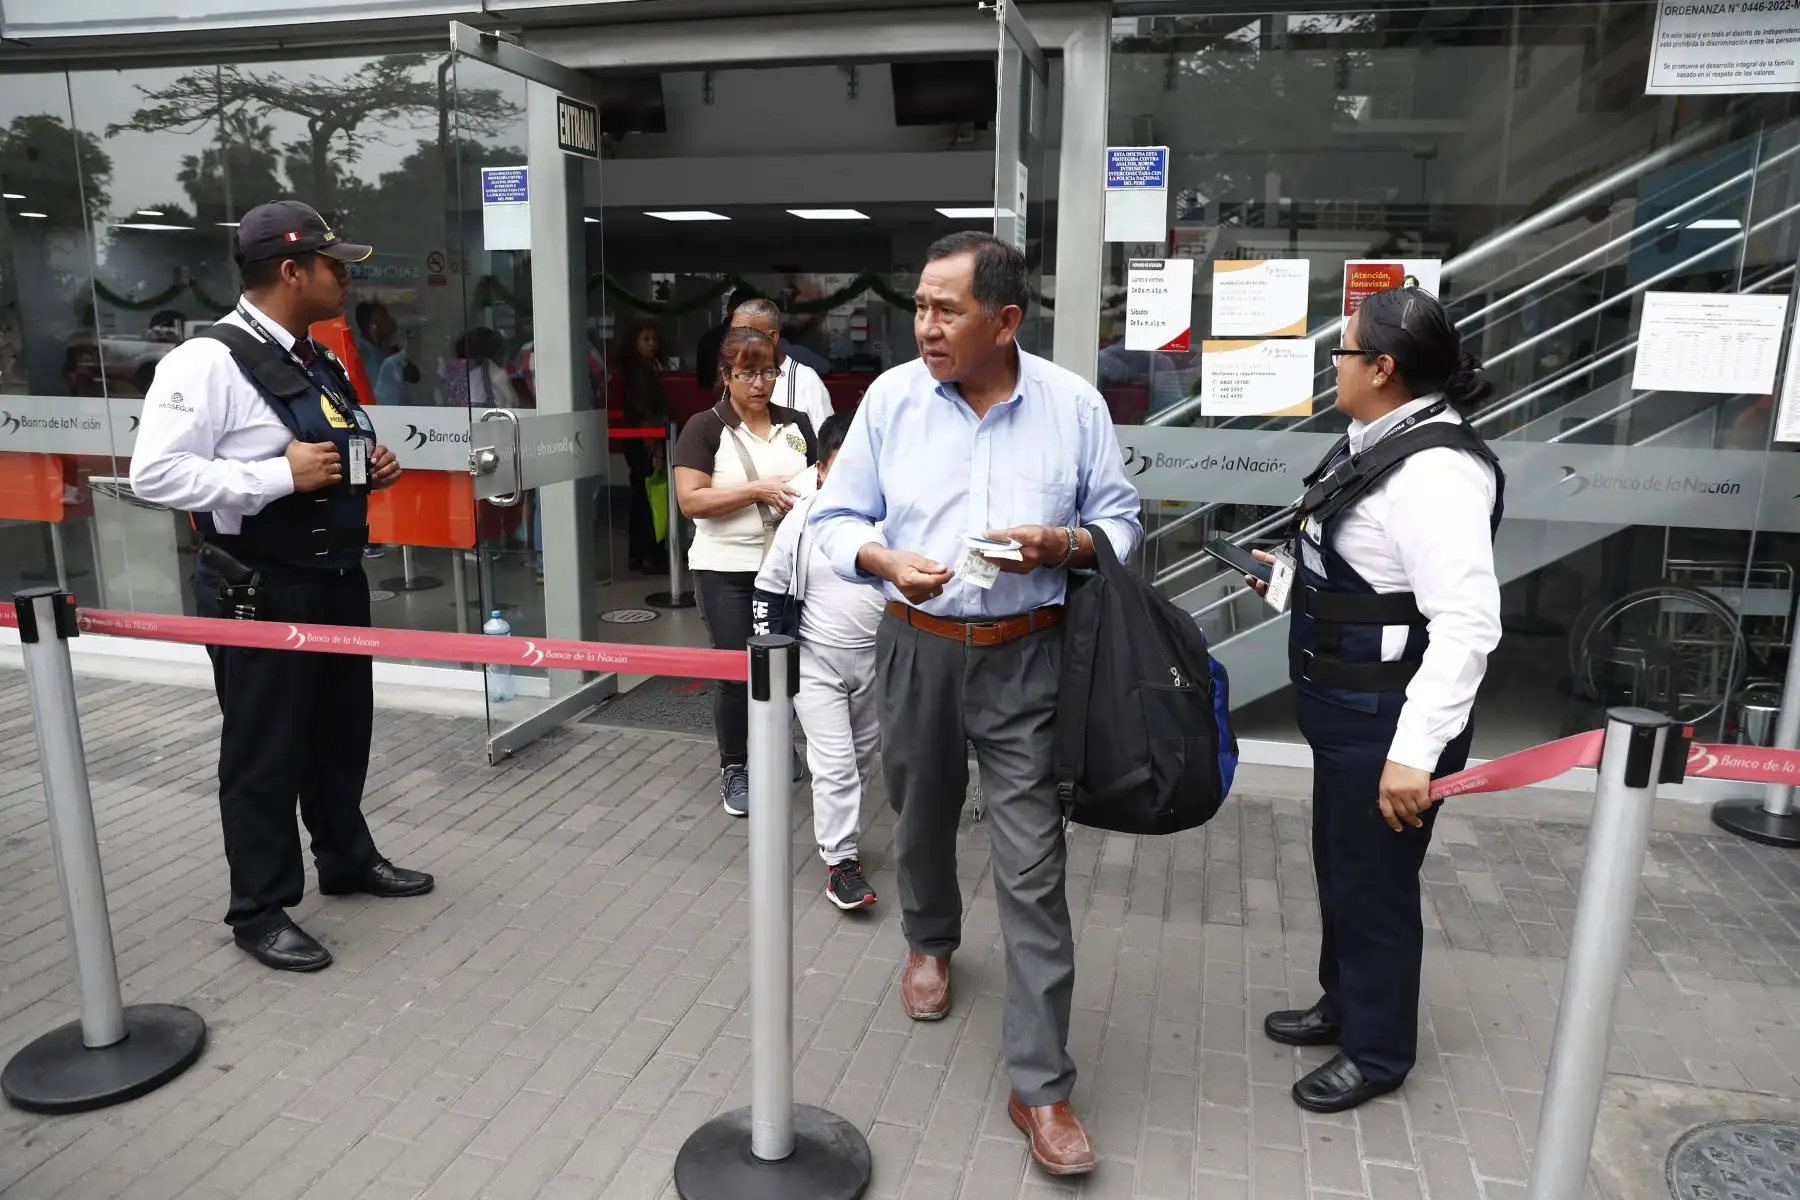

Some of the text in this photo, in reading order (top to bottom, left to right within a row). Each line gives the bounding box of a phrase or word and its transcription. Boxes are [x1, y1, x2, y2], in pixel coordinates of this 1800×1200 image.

[1664, 4, 1726, 16] ORDENANZA
[1735, 61, 1758, 69] integral
[559, 102, 596, 152] ENTRADA
[1351, 271, 1391, 280] ¡Atención,
[21, 415, 47, 428] Banco
[48, 416, 59, 429] de
[61, 416, 69, 429] la
[429, 429, 460, 443] Banco
[1155, 452, 1198, 469] Banco
[1200, 455, 1218, 470] de
[1221, 455, 1235, 471] la
[1592, 472, 1741, 495] Banco de la Nación
[306, 632, 380, 648] Banco de la Nación
[545, 650, 628, 664] Banco de la Nación
[1721, 754, 1796, 772] Banco de la
